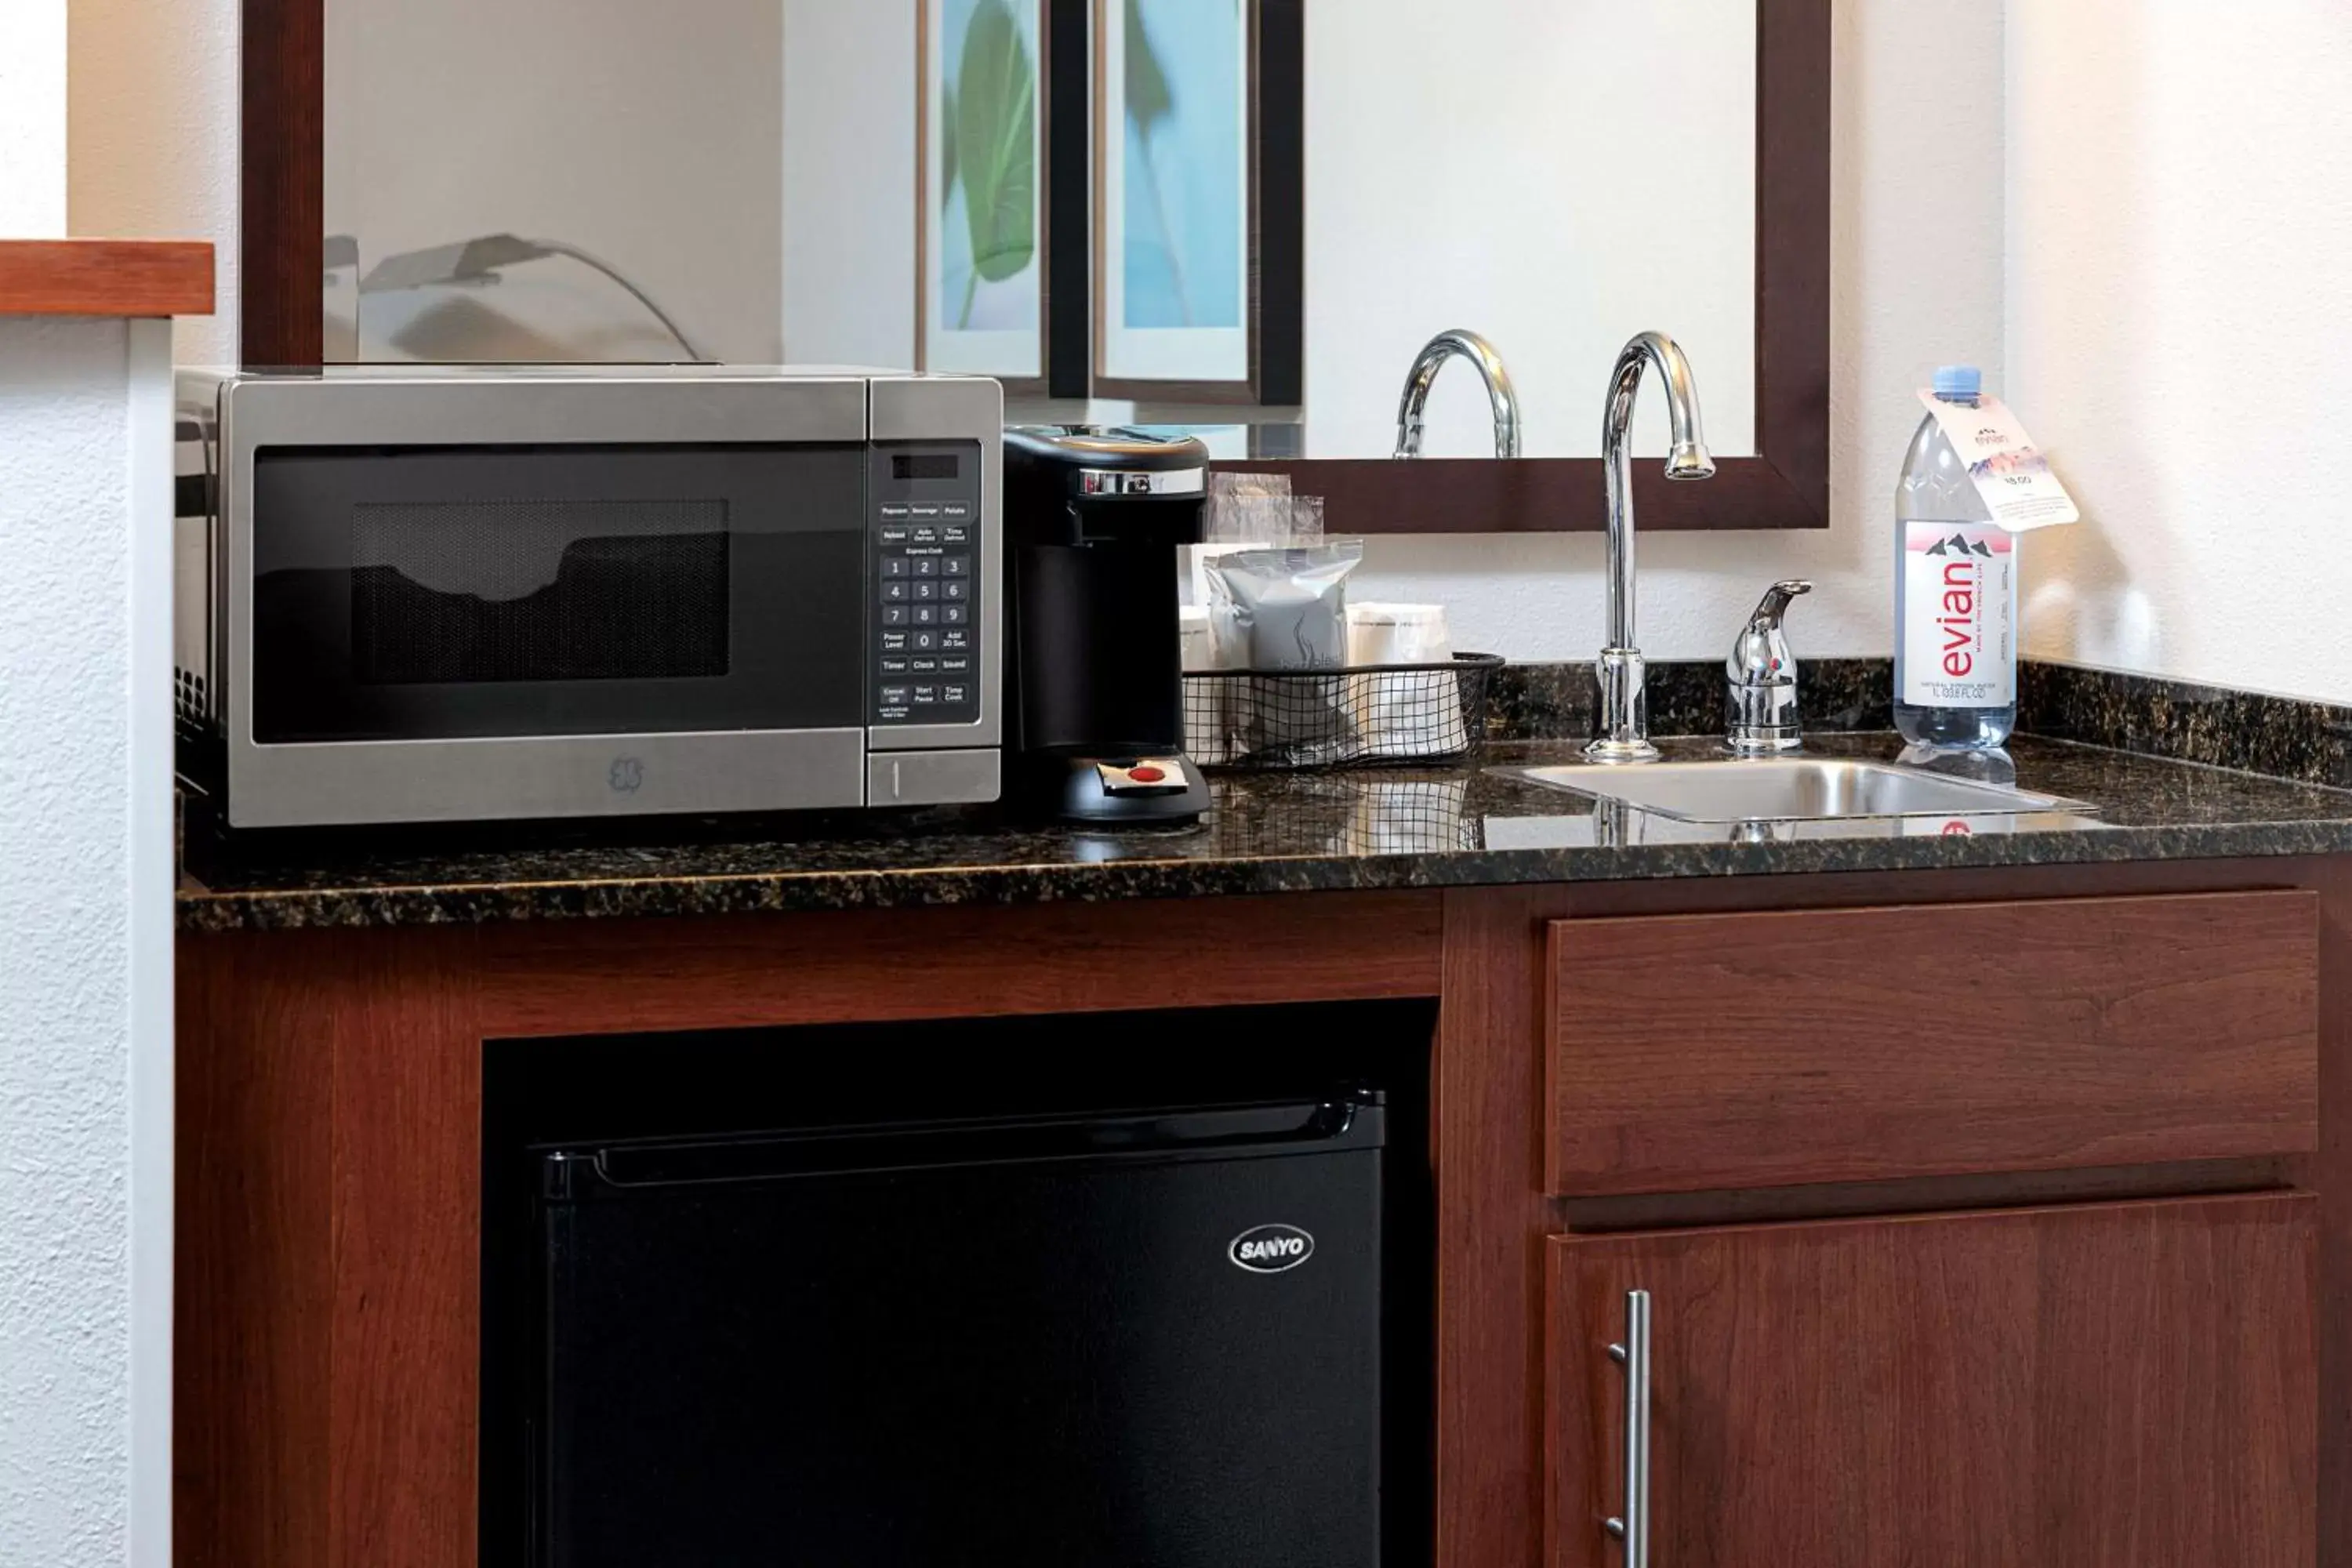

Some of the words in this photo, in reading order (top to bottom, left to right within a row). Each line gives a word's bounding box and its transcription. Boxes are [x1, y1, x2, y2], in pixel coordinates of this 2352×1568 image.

[893, 563, 898, 573] 1
[921, 562, 928, 573] 2
[949, 561, 958, 572] 3
[891, 586, 900, 597] 4
[921, 586, 928, 596] 5
[949, 585, 957, 596] 6
[891, 610, 899, 621] 7
[920, 610, 928, 620] 8
[949, 609, 957, 620] 9
[1936, 562, 1972, 677] evian
[920, 635, 928, 647] 0
[1240, 1236, 1304, 1260] SANYO
